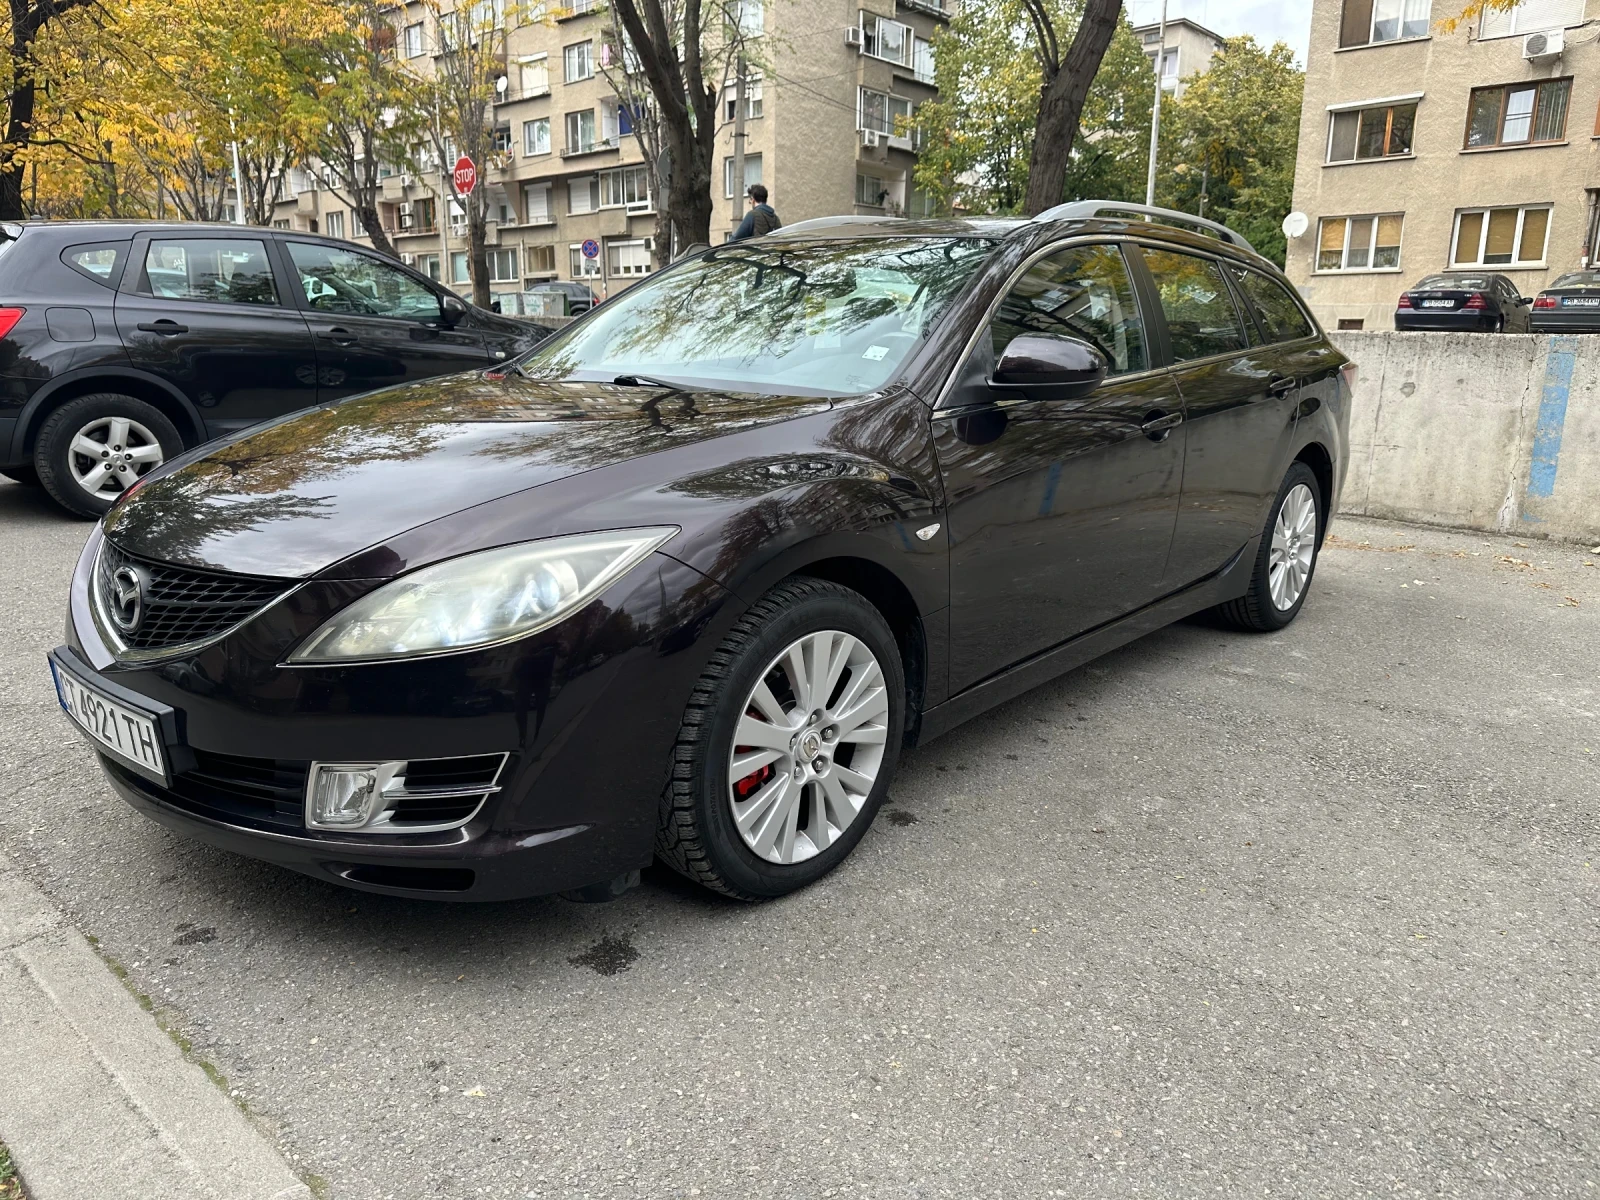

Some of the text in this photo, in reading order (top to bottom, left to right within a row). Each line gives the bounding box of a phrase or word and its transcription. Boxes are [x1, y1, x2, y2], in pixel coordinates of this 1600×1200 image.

[456, 168, 474, 184] STOP
[80, 688, 122, 749] 4921
[121, 713, 159, 767] TH
